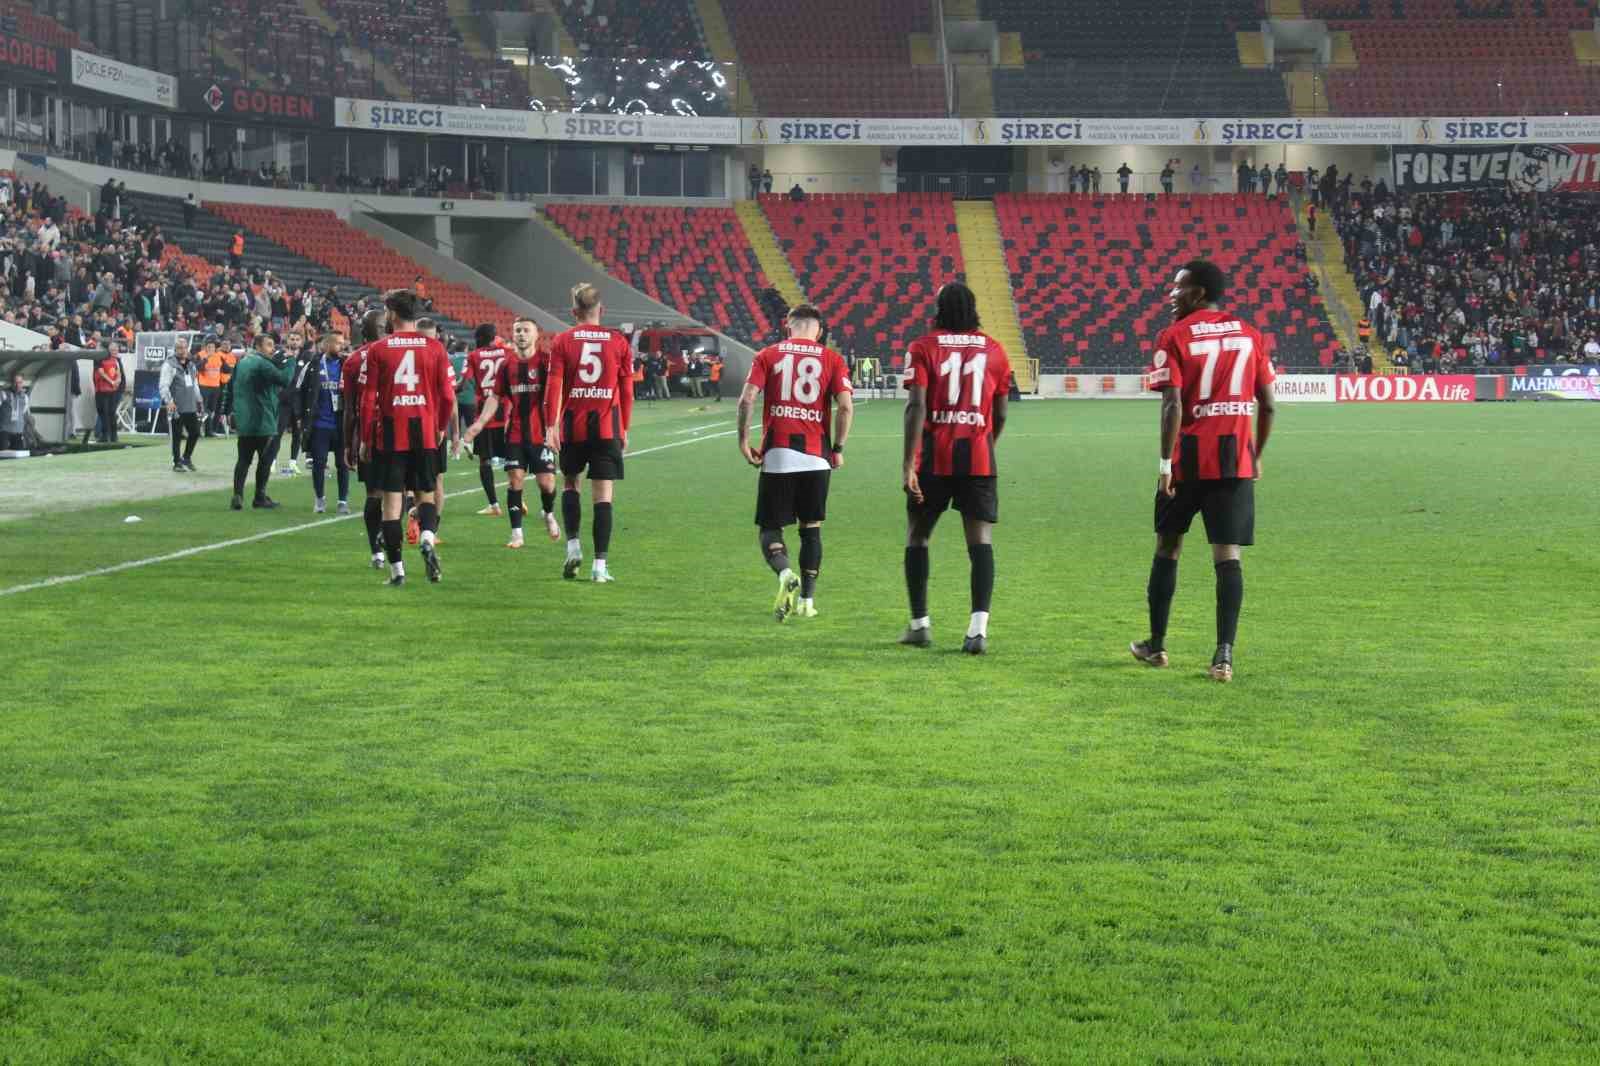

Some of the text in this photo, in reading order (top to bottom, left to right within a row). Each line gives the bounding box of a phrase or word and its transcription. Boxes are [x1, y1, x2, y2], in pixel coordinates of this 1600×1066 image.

[371, 102, 443, 128] ŞİRECİ
[780, 119, 861, 143] ŞİRECİ
[1001, 119, 1082, 143] ŞİRECİ
[1222, 119, 1304, 143] ŞİRECİ
[1444, 117, 1528, 142] ŞİRECİ
[1395, 151, 1527, 186] FOREVER
[394, 349, 420, 392] 4
[578, 342, 602, 383] 5
[1188, 337, 1253, 399] 77
[774, 353, 822, 404] 18
[940, 351, 987, 407] 11
[1339, 376, 1471, 401] MODA Life
[392, 394, 427, 406] ARDA
[1192, 401, 1255, 418] OKEREKE
[770, 405, 824, 423] SORESCU
